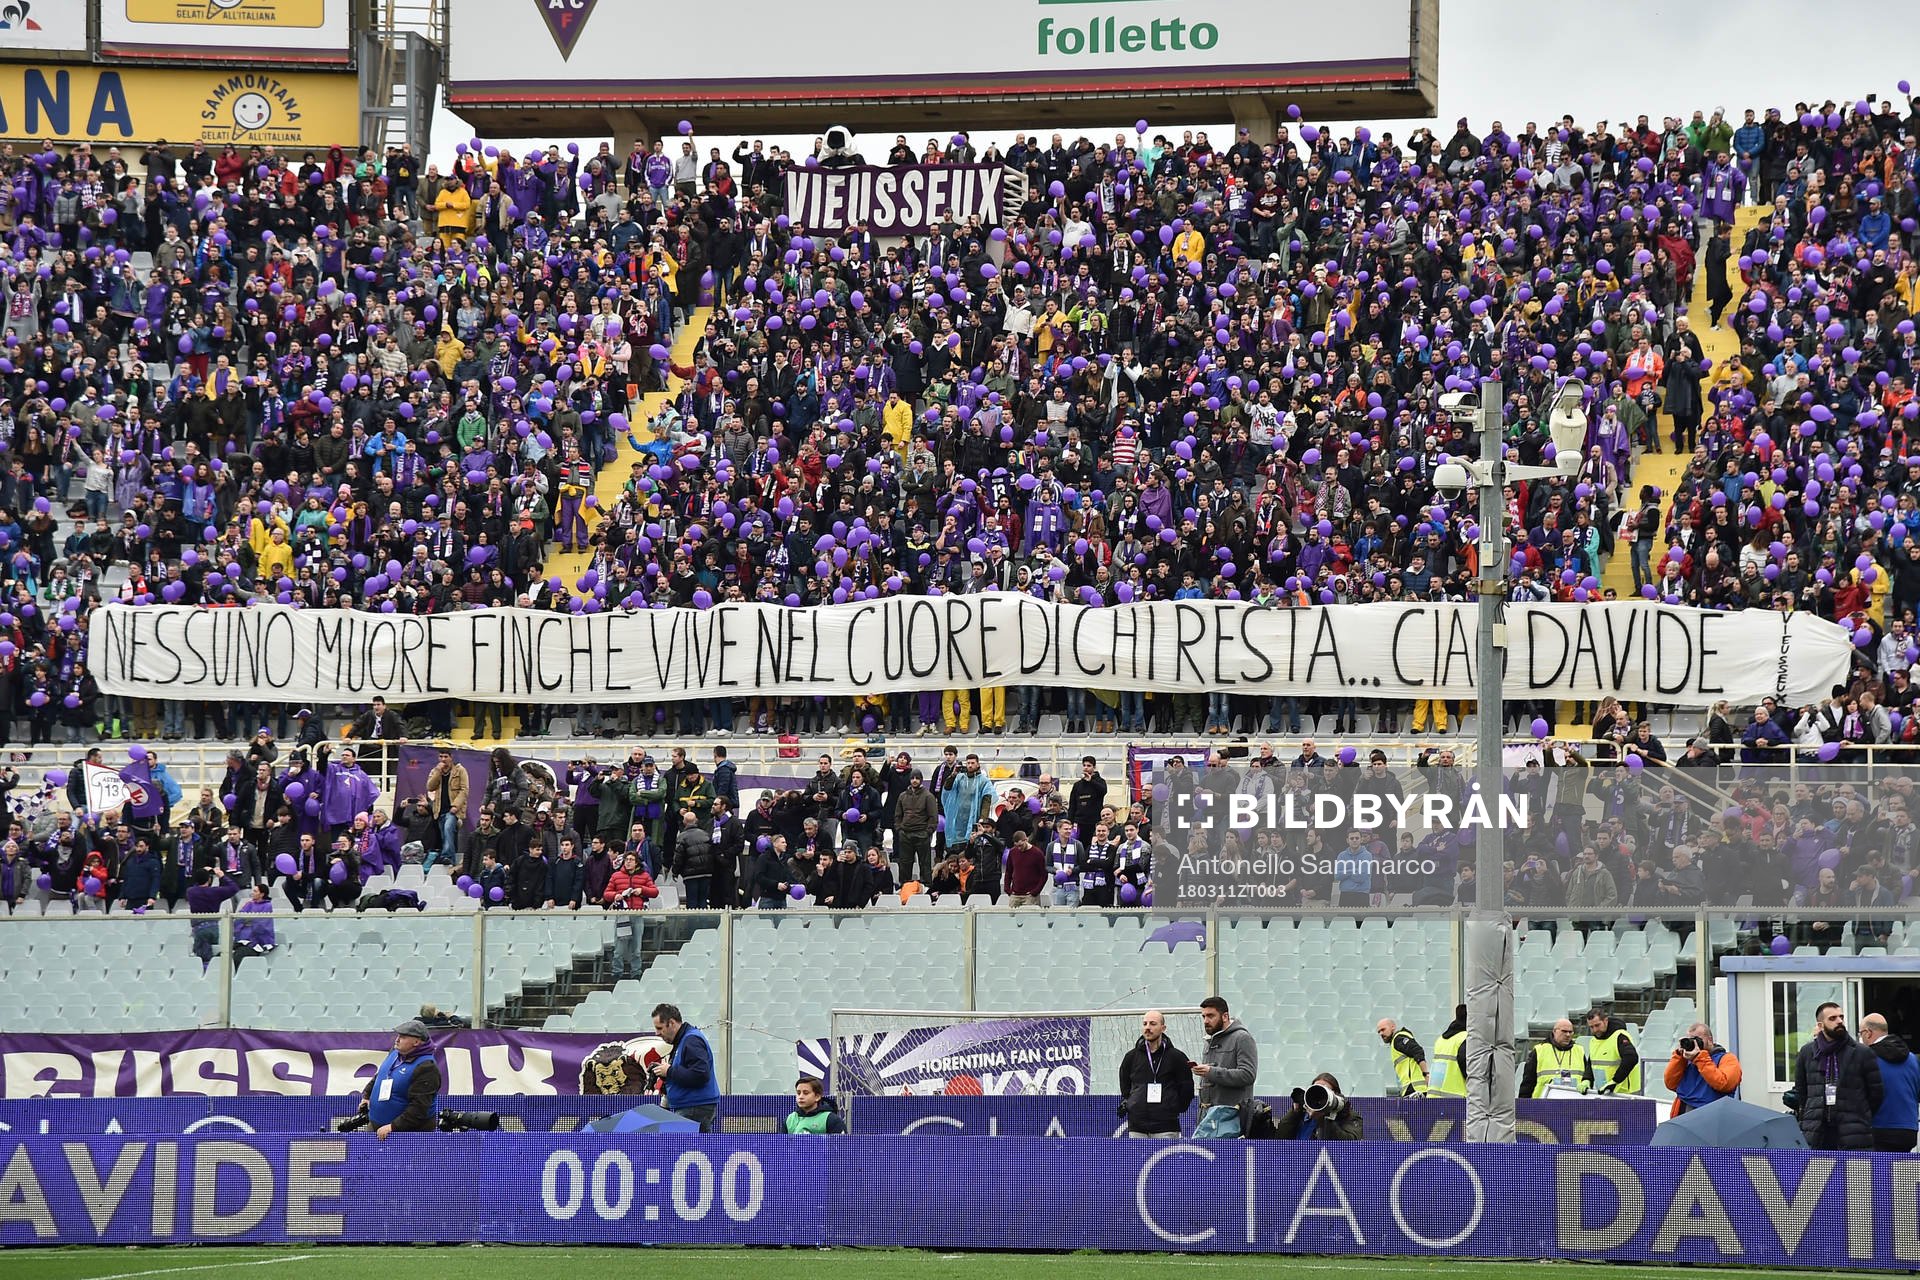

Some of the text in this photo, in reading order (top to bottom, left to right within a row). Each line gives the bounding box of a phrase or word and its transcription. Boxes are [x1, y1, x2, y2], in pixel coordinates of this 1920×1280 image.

[176, 9, 276, 21] GELATI ALL'ITALIANA
[1038, 15, 1219, 55] folletto
[0, 69, 134, 138] NA
[201, 73, 301, 122] SAMMONTANA
[201, 130, 302, 142] GELATI ALL'ITALIANA
[787, 167, 1003, 230] VIEUSSEUX
[104, 610, 295, 688] NESSUNO
[315, 616, 450, 693] MUORE
[650, 607, 739, 690] VIVE
[755, 608, 835, 688] NEL
[847, 598, 1003, 687] CUORE
[1019, 599, 1060, 676] DI
[1073, 606, 1156, 681] CHI
[1175, 604, 1381, 687] RESTA...
[1392, 608, 1478, 688] CIA
[1528, 608, 1724, 695] DAVIDE
[1776, 611, 1793, 704] VIEUSSEUX
[104, 784, 119, 797] 13
[918, 1044, 1083, 1074] FIORENTINA FAN CLUB
[541, 1149, 765, 1222] 00:00
[1136, 1144, 1485, 1248] CIAO
